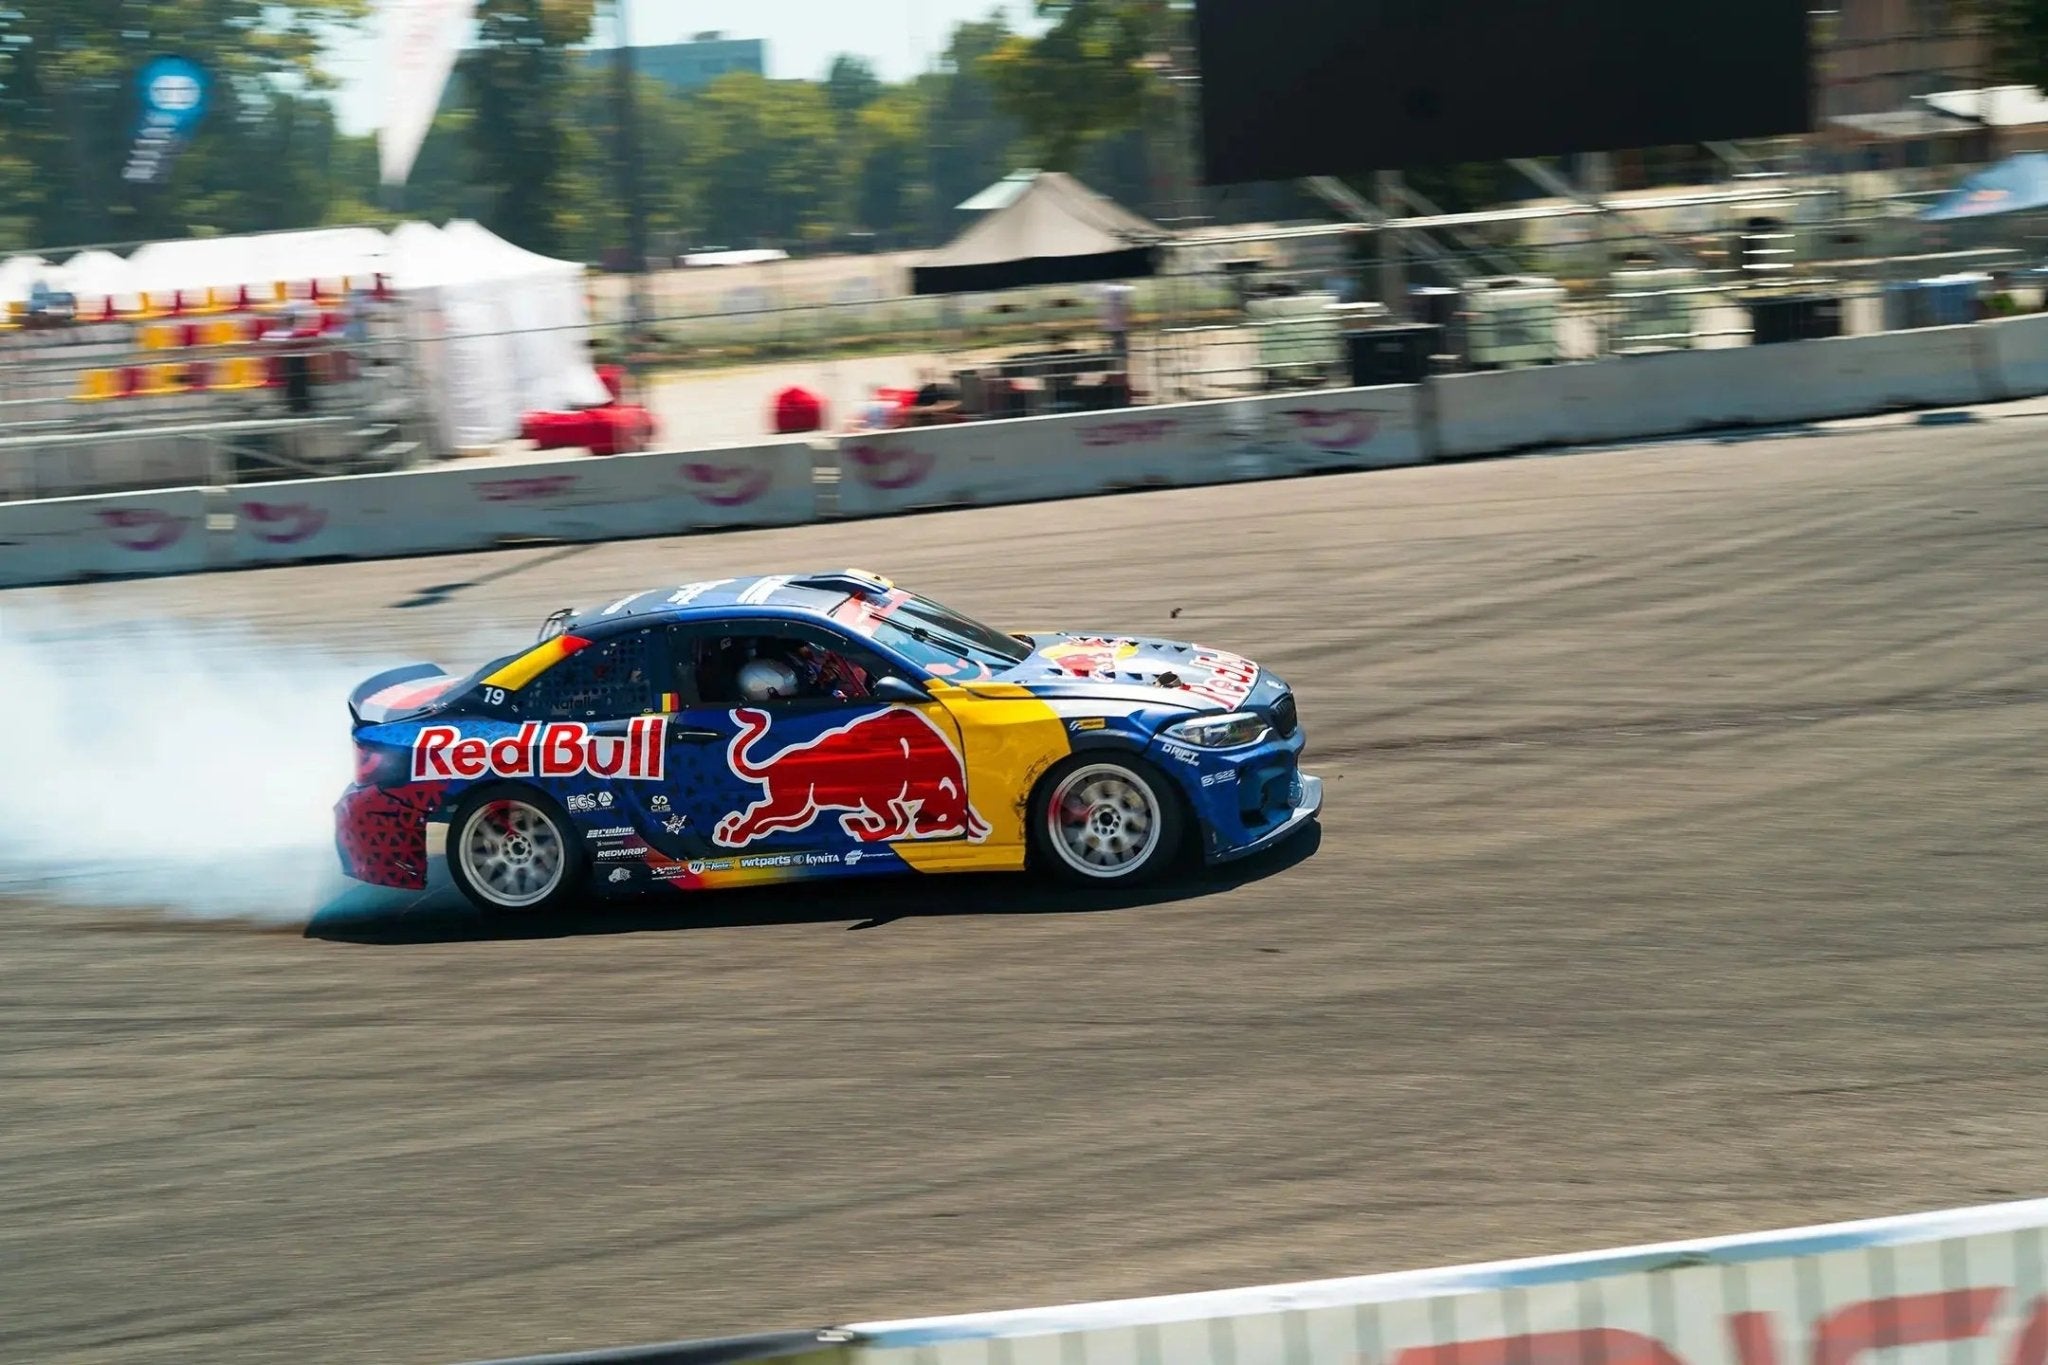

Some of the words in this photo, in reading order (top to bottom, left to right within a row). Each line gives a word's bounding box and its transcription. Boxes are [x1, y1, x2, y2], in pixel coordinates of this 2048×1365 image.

[1177, 660, 1260, 712] Red
[483, 687, 505, 706] 19
[412, 721, 539, 780] Red
[540, 716, 667, 780] Bull
[566, 792, 597, 810] EGS
[741, 855, 791, 868] wrtparts
